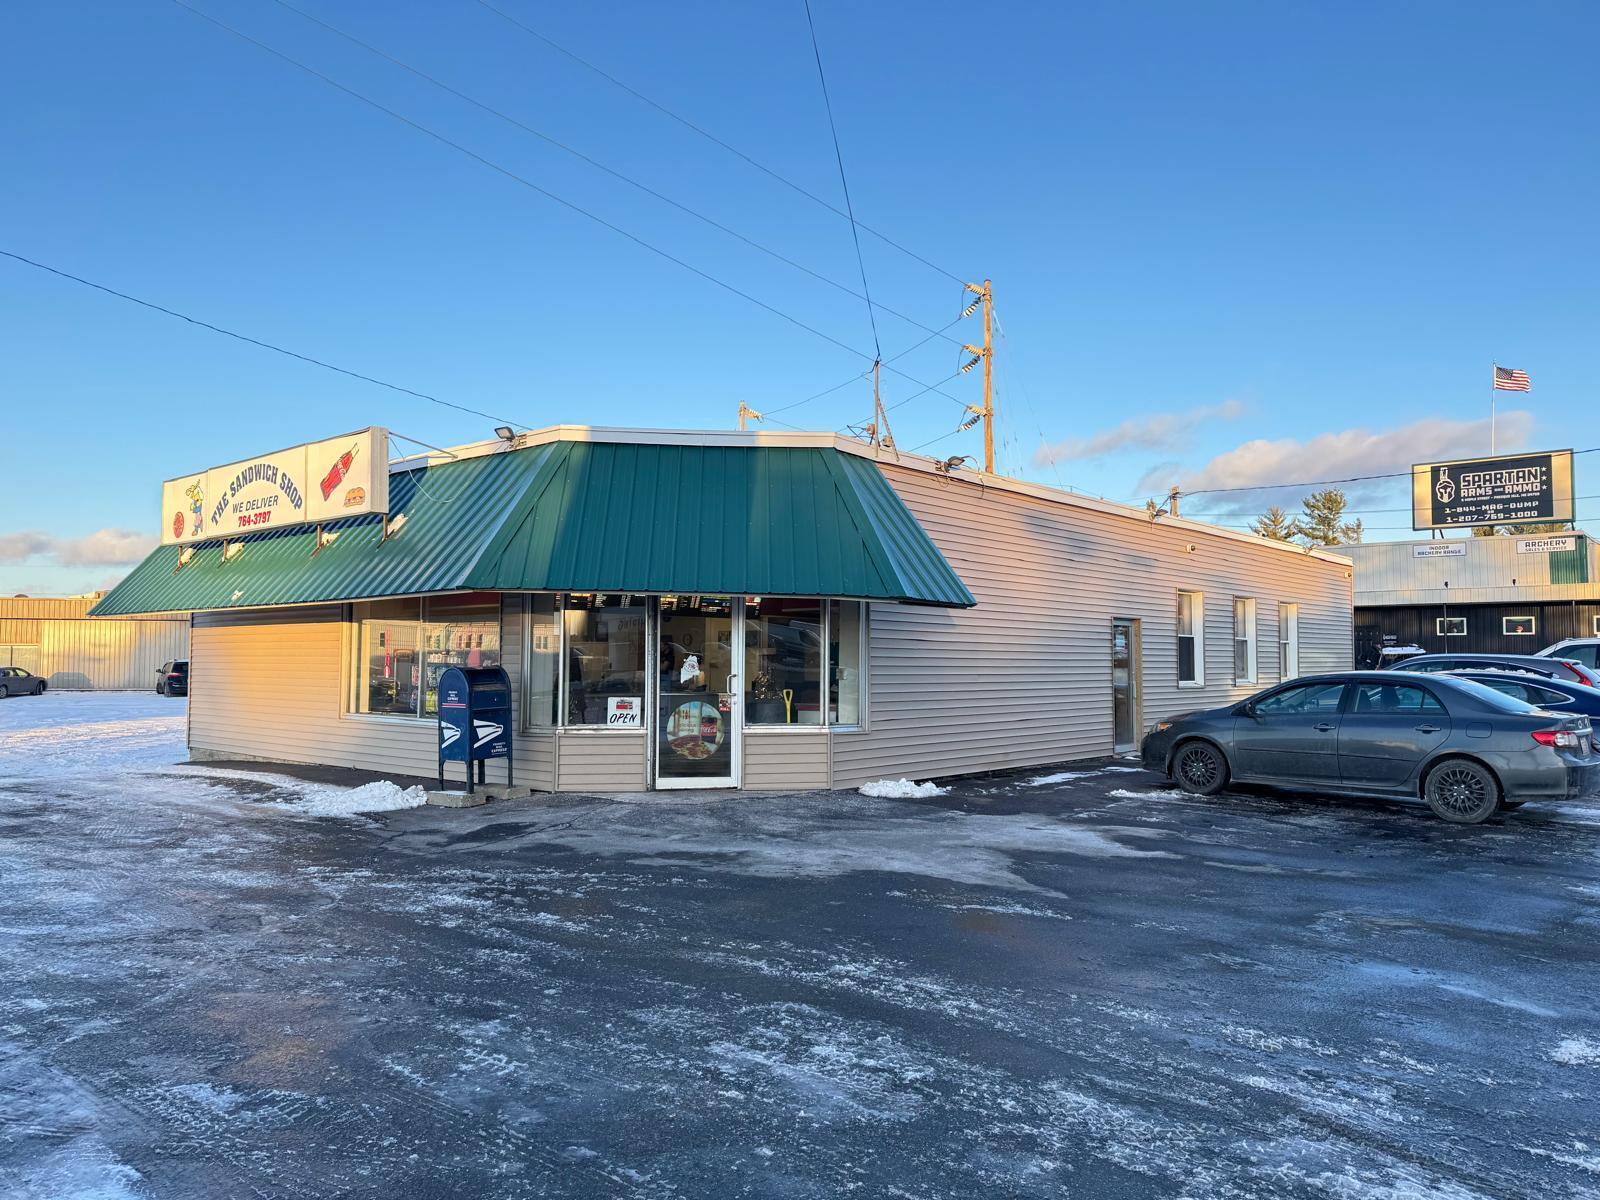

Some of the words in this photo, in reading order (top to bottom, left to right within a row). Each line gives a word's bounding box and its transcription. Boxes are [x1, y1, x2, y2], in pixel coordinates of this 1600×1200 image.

[1460, 466, 1541, 489] SPARTAN
[211, 491, 230, 526] THE
[229, 463, 279, 498] SANDWICH
[279, 472, 303, 510] SHOP
[1460, 487, 1493, 498] ARMS
[1504, 482, 1541, 494] AMMO
[232, 502, 244, 514] WE
[245, 495, 279, 511] DELIVER
[1444, 501, 1539, 514] 1-844-MAG-DUMP
[238, 510, 272, 528] 764-3797
[1525, 539, 1567, 548] ARCHERY
[609, 712, 638, 724] OPEN
